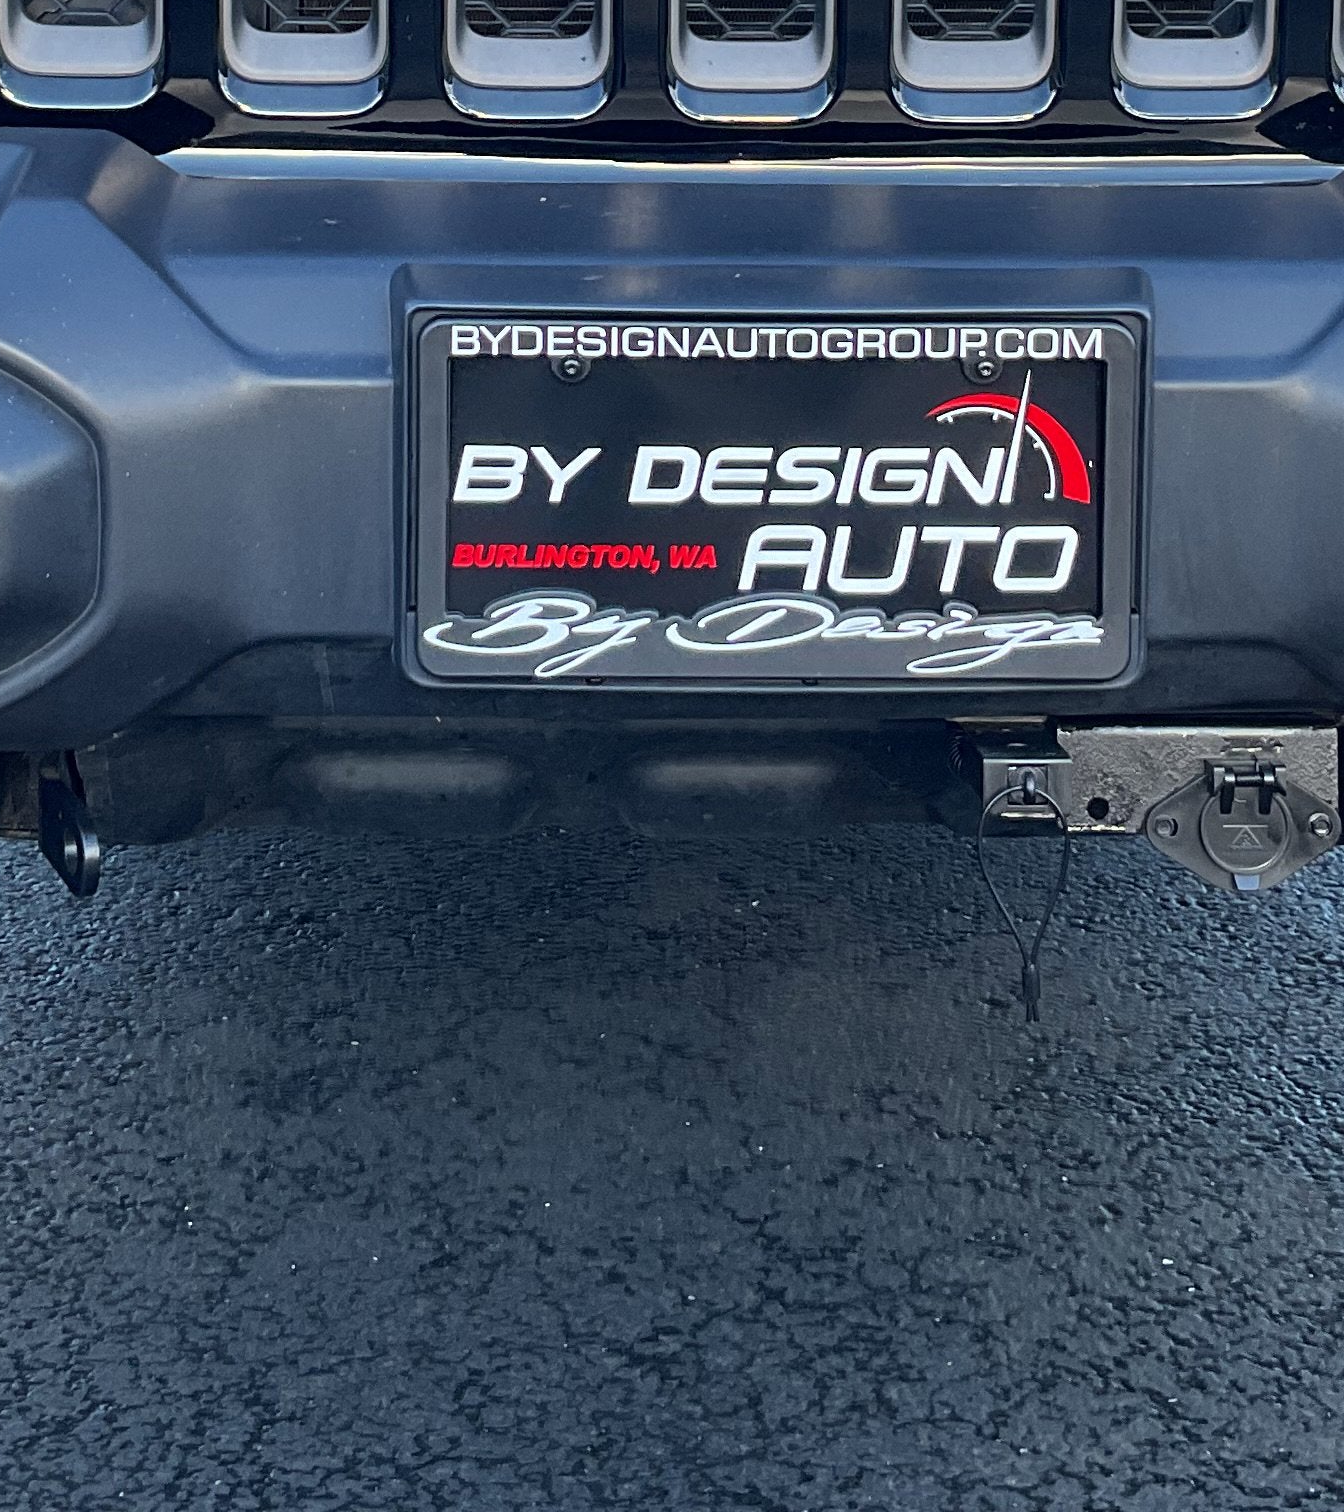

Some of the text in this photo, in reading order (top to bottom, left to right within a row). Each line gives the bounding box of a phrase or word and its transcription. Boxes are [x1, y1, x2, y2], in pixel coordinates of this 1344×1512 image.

[450, 325, 1104, 360] BYDESIGNAUTOGROUP.COM
[452, 444, 1006, 505] BY DESIGN
[451, 544, 718, 575] BURLINGTON, WA
[737, 524, 1079, 593] AUTO
[423, 598, 1104, 677] By Design
